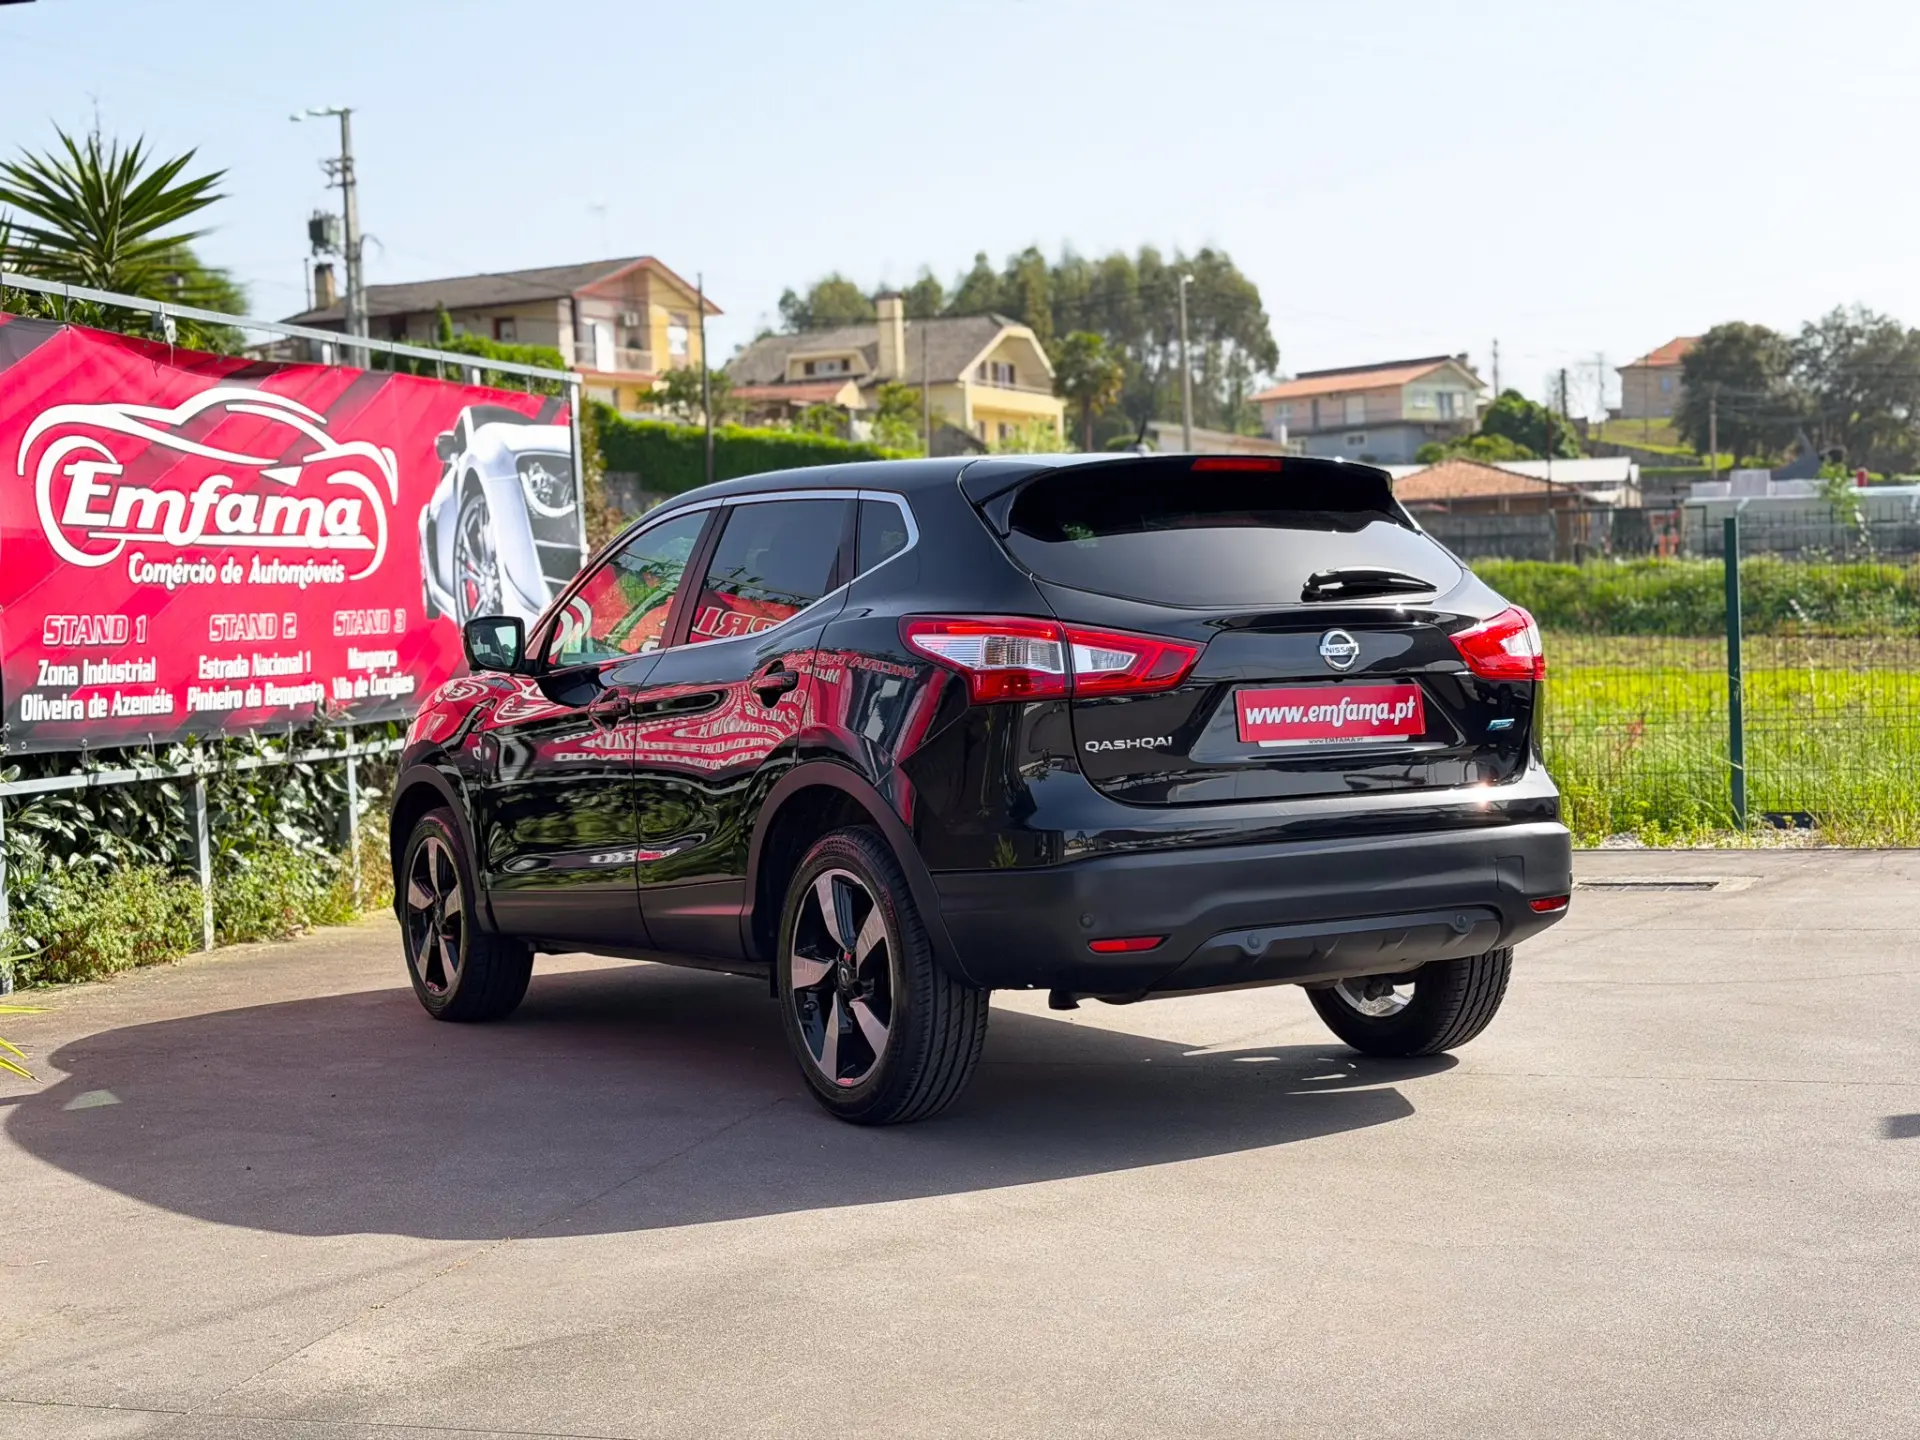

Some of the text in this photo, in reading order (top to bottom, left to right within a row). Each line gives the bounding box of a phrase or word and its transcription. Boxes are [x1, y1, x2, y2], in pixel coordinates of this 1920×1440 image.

[61, 460, 363, 549] Emfama
[129, 552, 346, 590] Comércio de Automóveis
[43, 615, 147, 645] STAND 1
[209, 612, 298, 642] STAND 2
[333, 608, 407, 637] STAND 3
[37, 656, 157, 686] Zona Industrial
[198, 651, 312, 680] Estrada Nacional 1
[186, 681, 325, 712] Pinheiro da Bemposta
[354, 676, 369, 698] de
[20, 688, 174, 722] Oliveira de Azeméis
[1246, 695, 1416, 727] www.emfama.pt
[1085, 736, 1173, 753] QASHQAI
